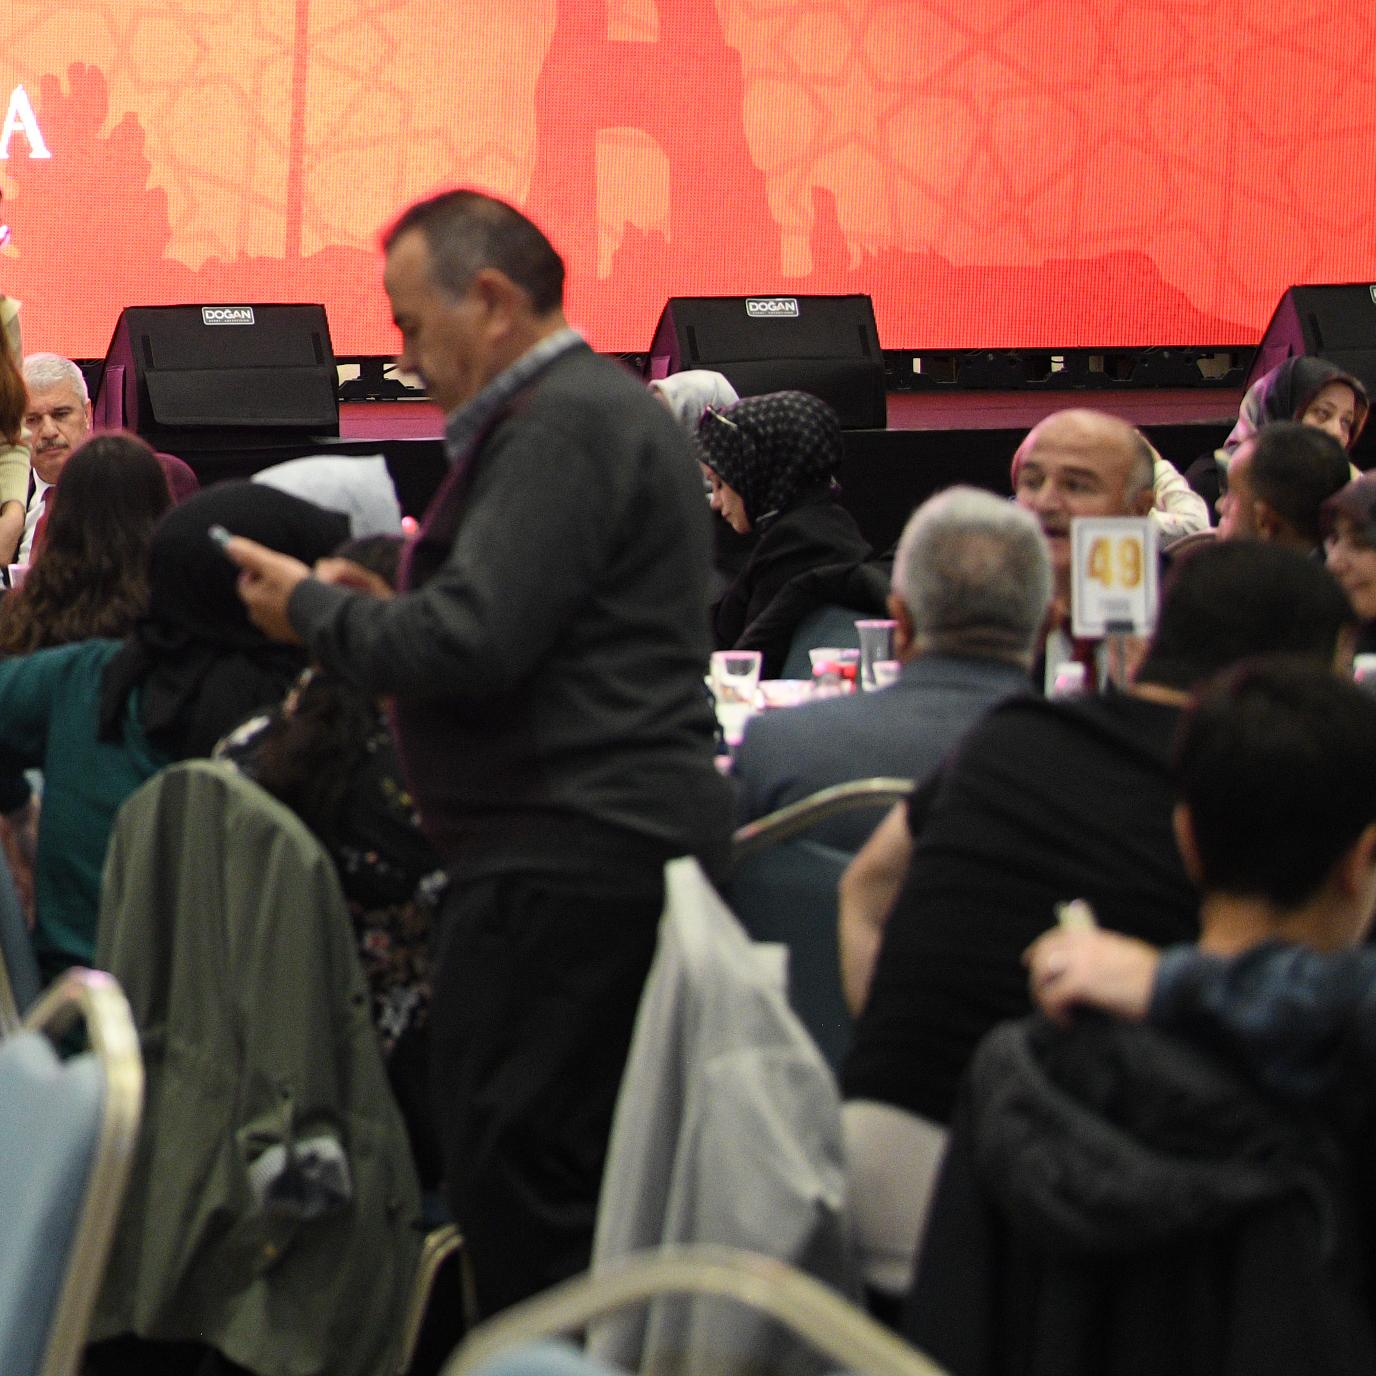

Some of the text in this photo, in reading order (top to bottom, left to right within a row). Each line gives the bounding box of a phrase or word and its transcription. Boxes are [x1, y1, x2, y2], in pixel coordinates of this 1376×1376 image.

[749, 300, 795, 312] DOĞAN
[205, 308, 251, 320] DOĞAN
[1086, 536, 1142, 589] 49
